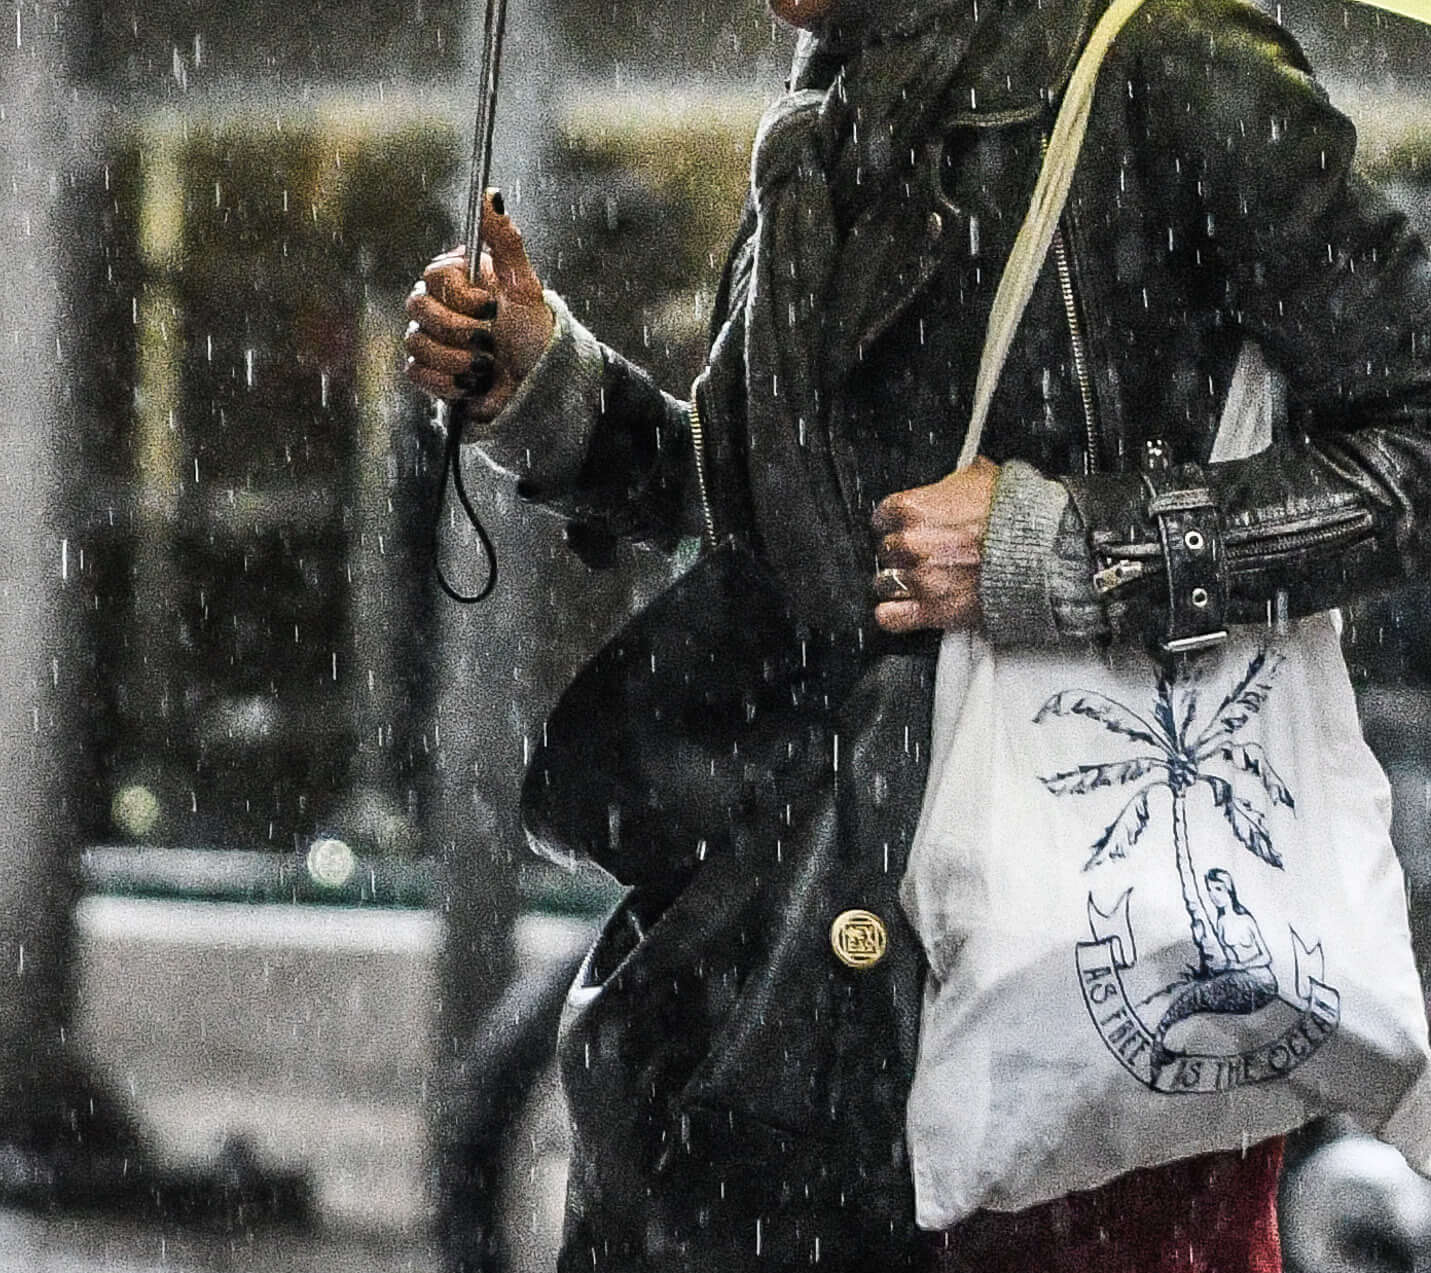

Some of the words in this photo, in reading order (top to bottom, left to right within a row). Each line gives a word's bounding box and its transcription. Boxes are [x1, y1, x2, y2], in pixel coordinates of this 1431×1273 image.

[1083, 966, 1117, 1004] AS
[1100, 1005, 1151, 1067] FREE
[1169, 1058, 1201, 1087] IS
[1214, 1054, 1263, 1085] THE
